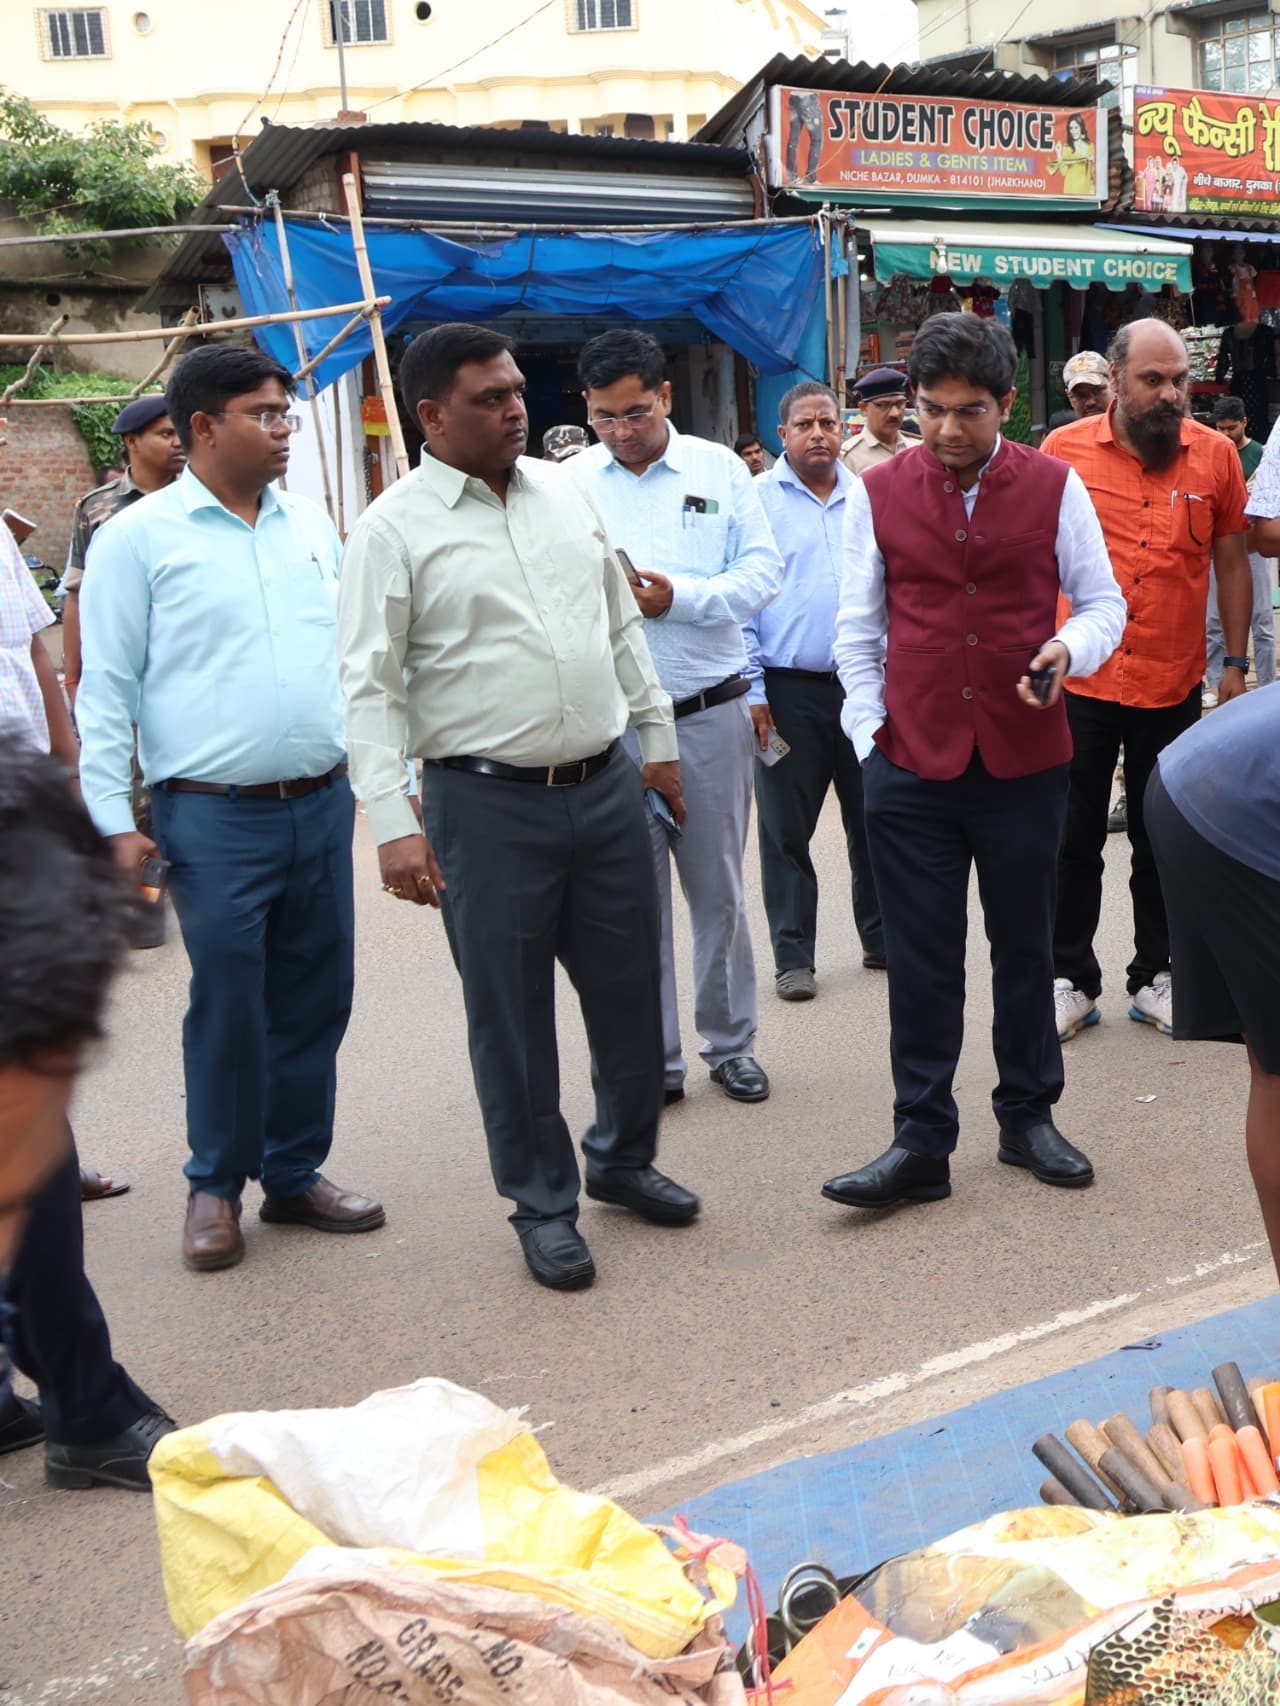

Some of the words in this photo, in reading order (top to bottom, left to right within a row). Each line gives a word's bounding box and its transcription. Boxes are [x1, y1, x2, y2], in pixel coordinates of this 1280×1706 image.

[827, 98, 954, 146] STUDENT
[962, 105, 1057, 152] CHOICE
[1137, 101, 1182, 156] न्यू
[860, 150, 913, 168] LADIES
[919, 154, 931, 168] &
[937, 153, 988, 171] GENTS
[992, 156, 1028, 172] ITEM
[839, 170, 869, 182] NICHE
[871, 171, 904, 184] BAZAR,
[907, 172, 940, 184] DUMKA
[950, 173, 984, 187] 814101
[987, 174, 1047, 190] (JHARKHAND)
[930, 250, 982, 273] NEW
[994, 255, 1096, 277] STUDENT
[1103, 258, 1178, 281] CHOICE
